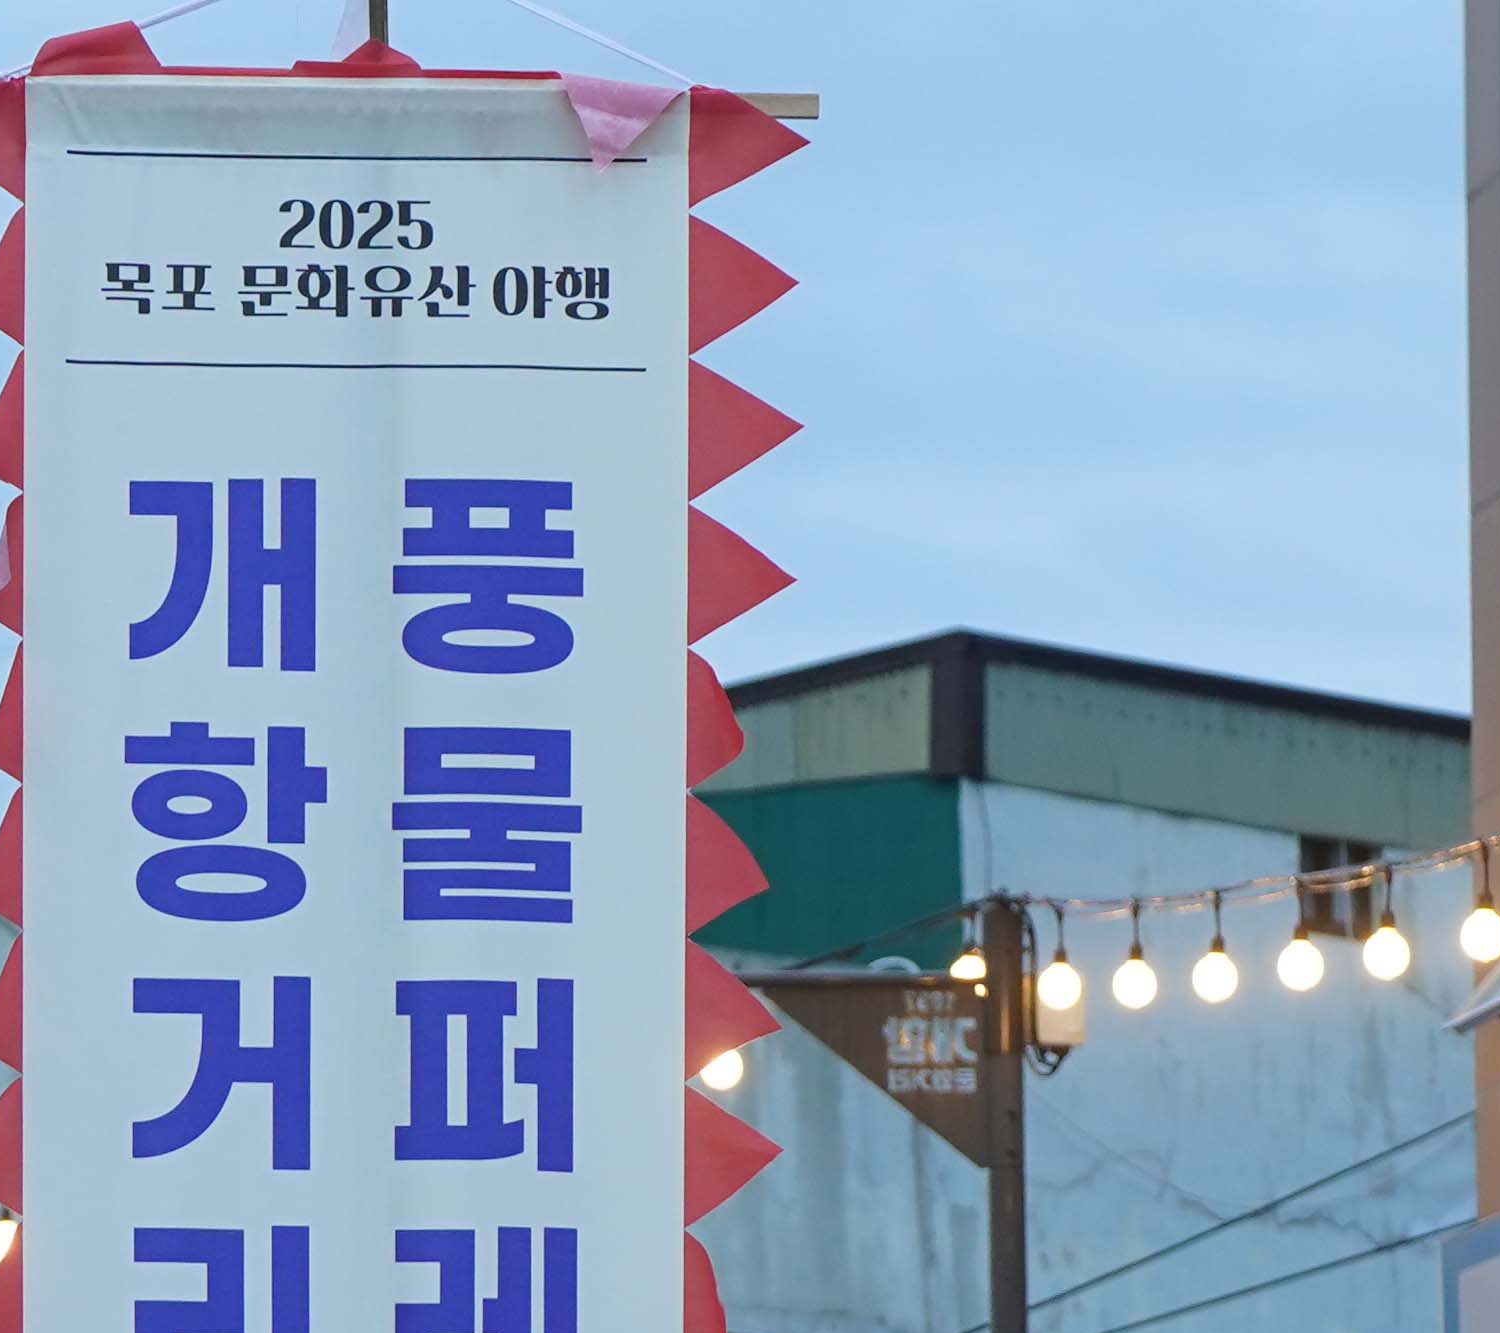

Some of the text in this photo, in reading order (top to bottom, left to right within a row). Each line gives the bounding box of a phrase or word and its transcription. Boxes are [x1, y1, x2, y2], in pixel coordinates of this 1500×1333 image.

[278, 198, 434, 252] 2025
[101, 262, 611, 321] 목포 문화유산 야행
